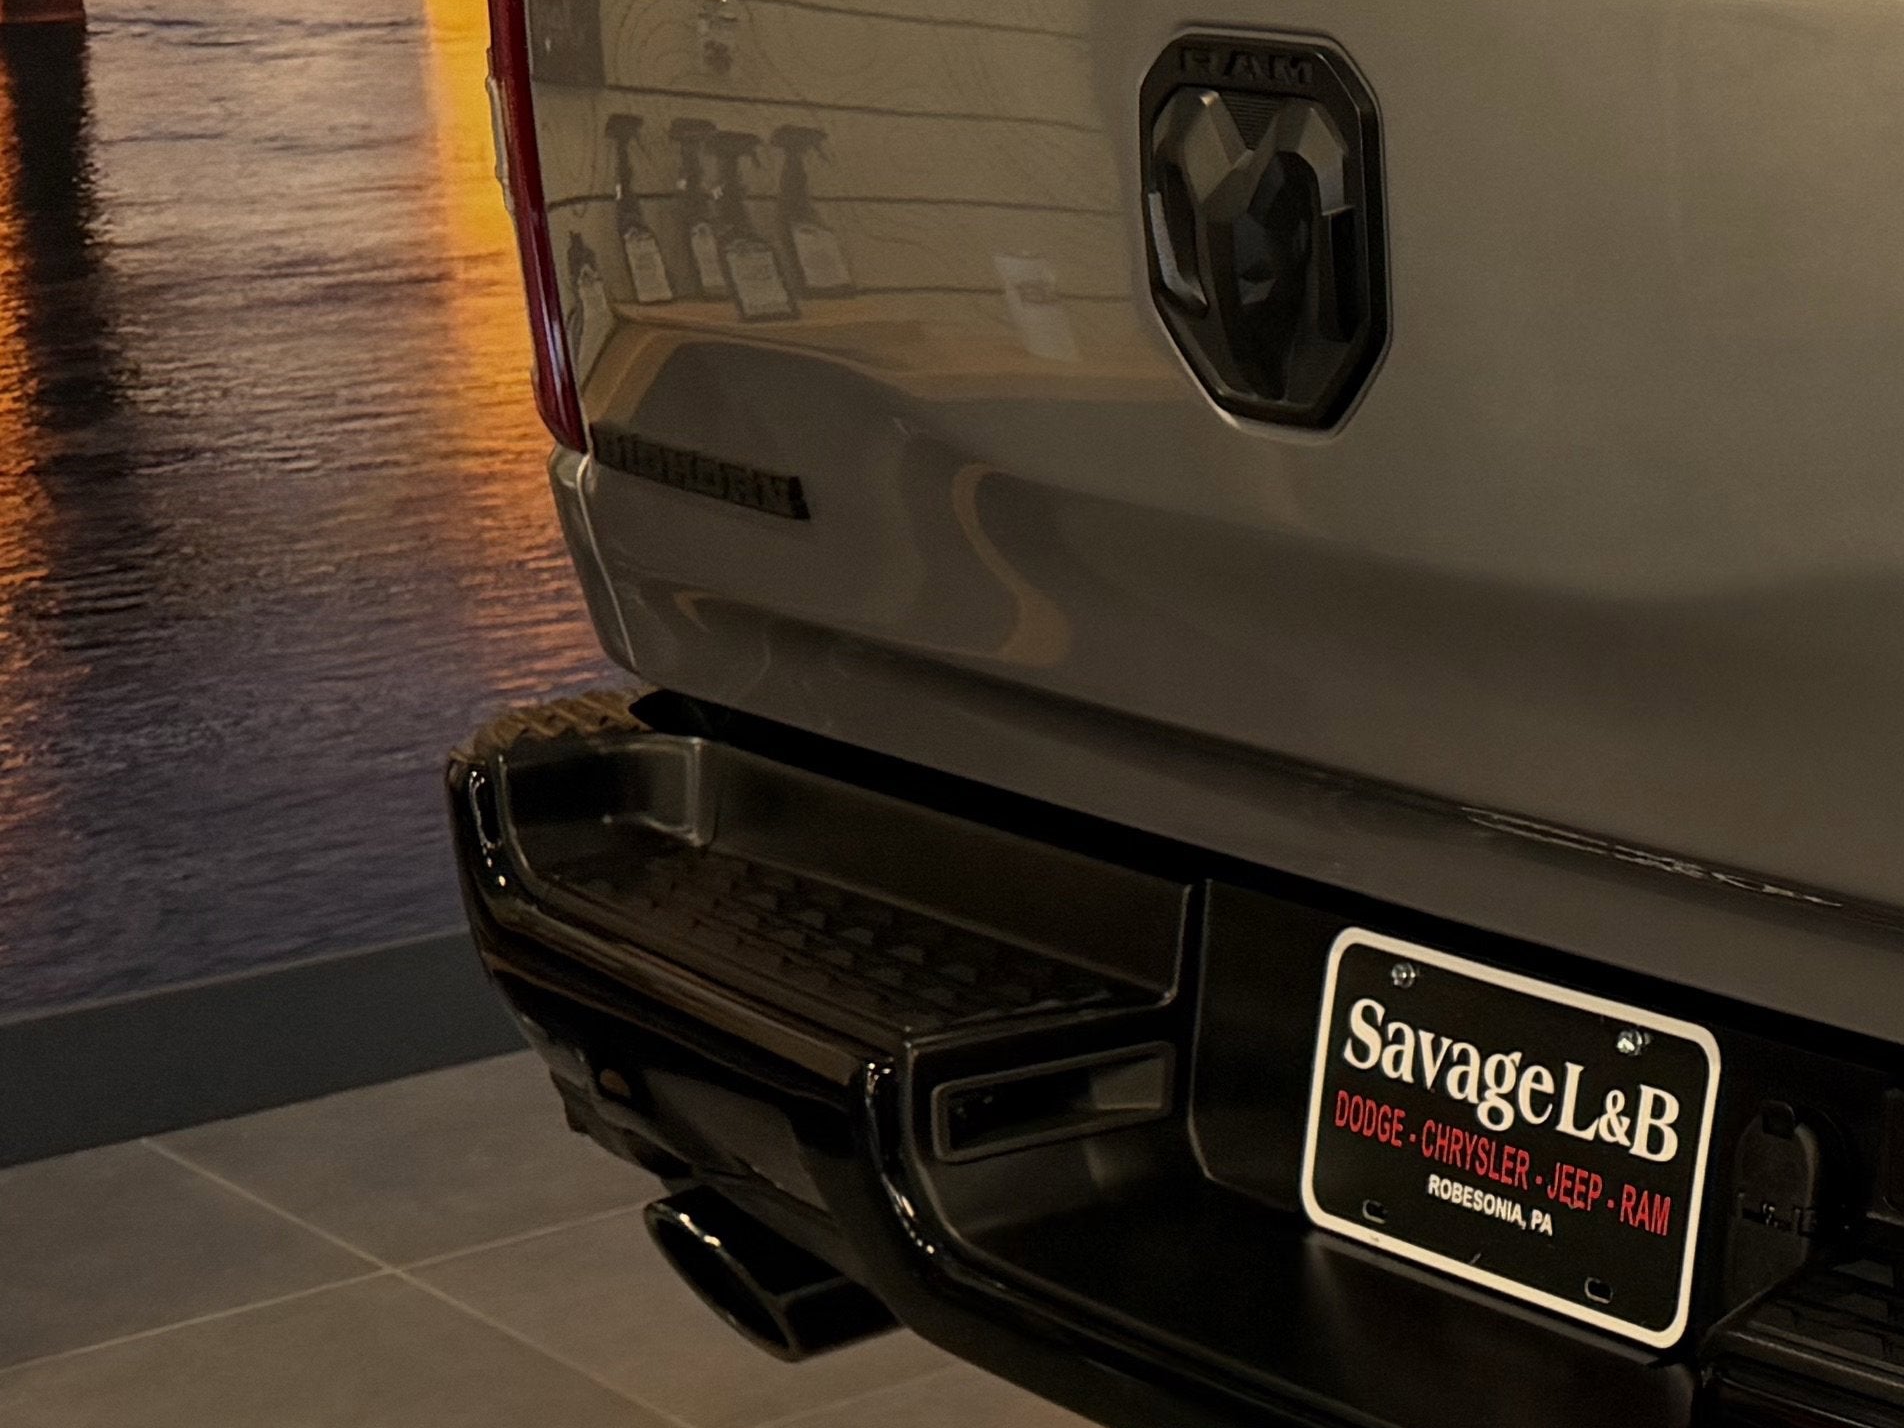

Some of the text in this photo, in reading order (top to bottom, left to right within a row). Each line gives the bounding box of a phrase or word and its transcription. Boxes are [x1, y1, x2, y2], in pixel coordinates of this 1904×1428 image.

[1178, 45, 1313, 84] RAM
[1334, 1091, 1672, 1236] DODGE CHRYSLER JEEP RAM
[1428, 1174, 1554, 1236] ROBESONIA, PA
